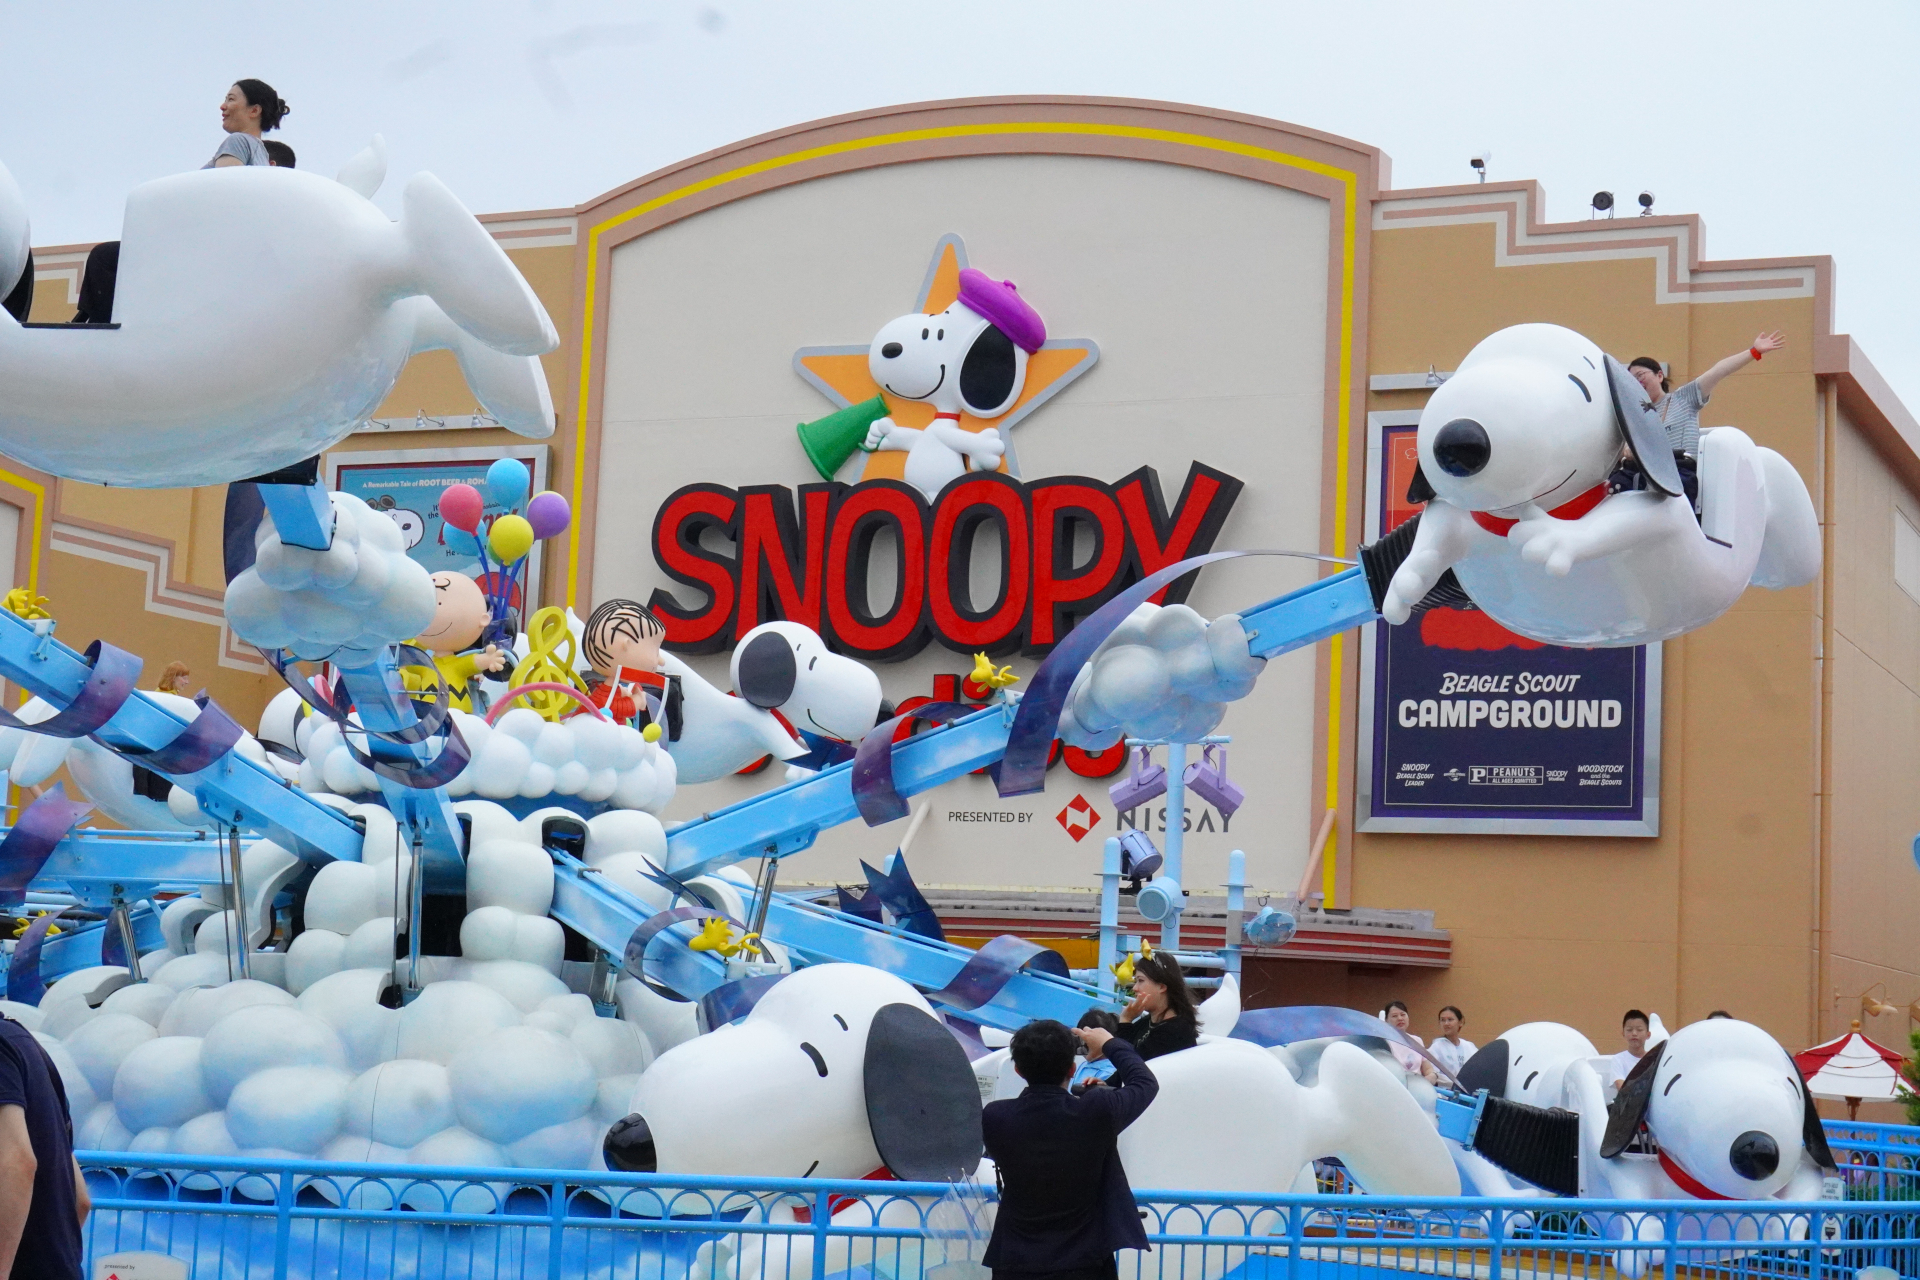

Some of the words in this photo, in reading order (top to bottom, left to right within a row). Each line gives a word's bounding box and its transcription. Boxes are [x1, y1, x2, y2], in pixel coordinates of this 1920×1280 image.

[419, 479, 440, 487] ROOT
[441, 478, 460, 486] BEER
[648, 460, 1244, 663] SNOOPY
[1439, 672, 1513, 695] BEAGLE
[1515, 672, 1581, 695] SCOUT
[1398, 699, 1622, 728] CAMPGROUND
[1401, 763, 1430, 771] SNOOPY
[1493, 768, 1535, 776] PEANUTS
[1577, 765, 1624, 773] WOODSTOCK
[1416, 772, 1434, 780] SCOUT
[1471, 768, 1486, 782] P
[948, 811, 1015, 823] PRESENTED
[1018, 812, 1033, 823] BY
[1117, 807, 1234, 833] NISSAY
